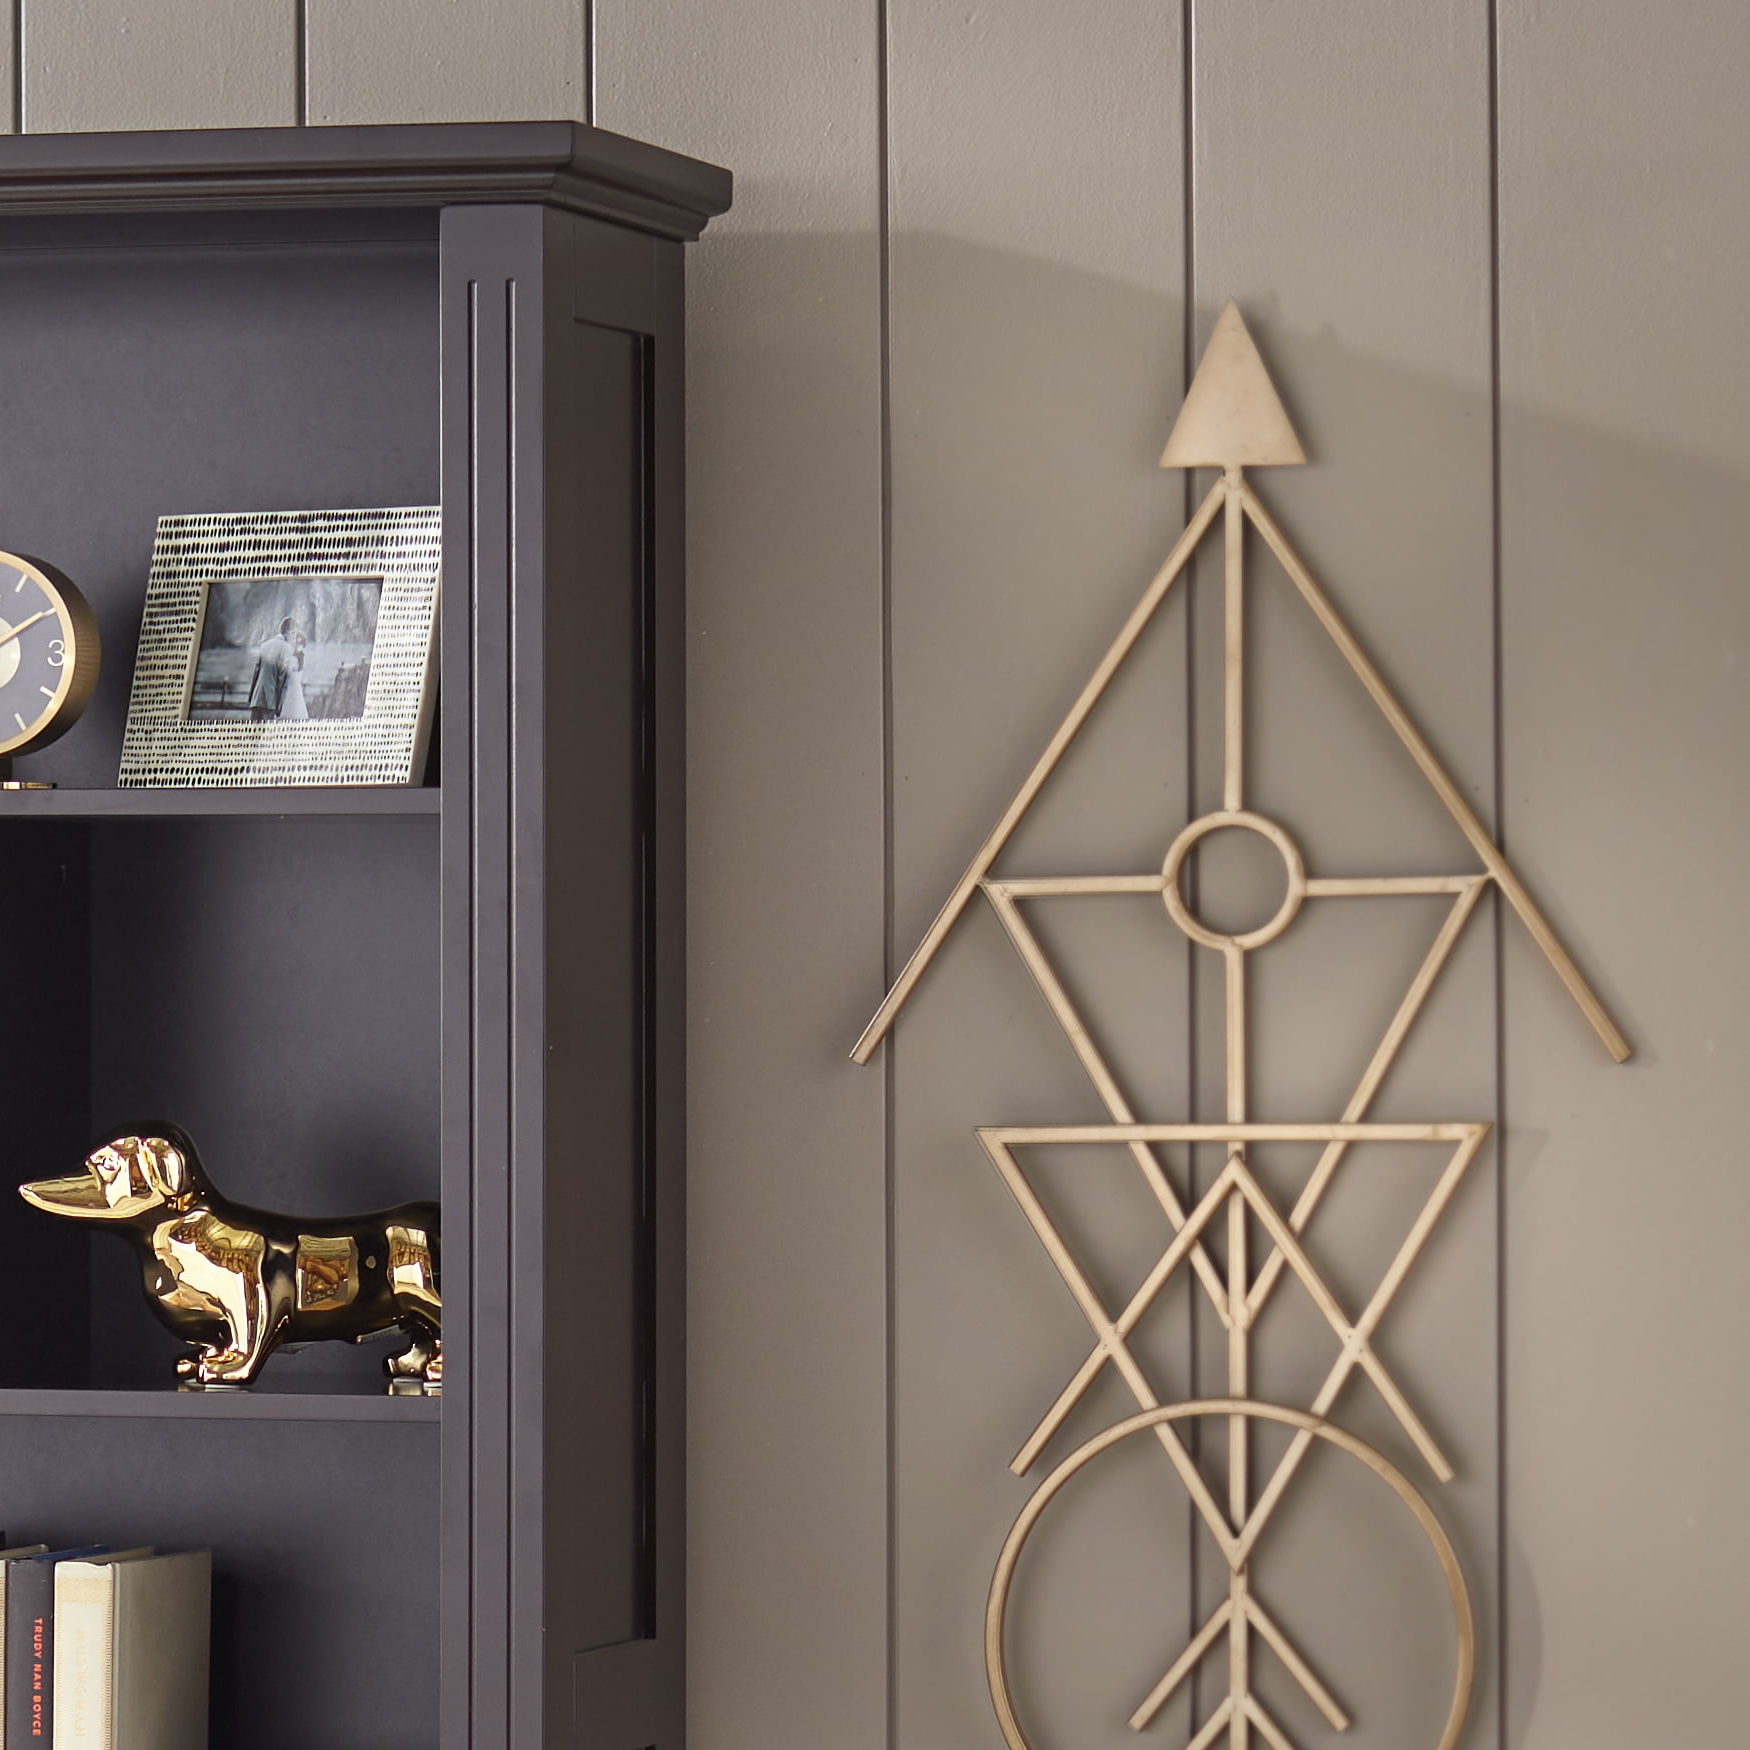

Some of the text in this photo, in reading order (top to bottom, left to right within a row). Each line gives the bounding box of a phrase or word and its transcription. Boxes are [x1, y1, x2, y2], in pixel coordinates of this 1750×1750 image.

[47, 639, 65, 667] 3
[32, 1618, 43, 1736] TRUDY NAN BOYCE
